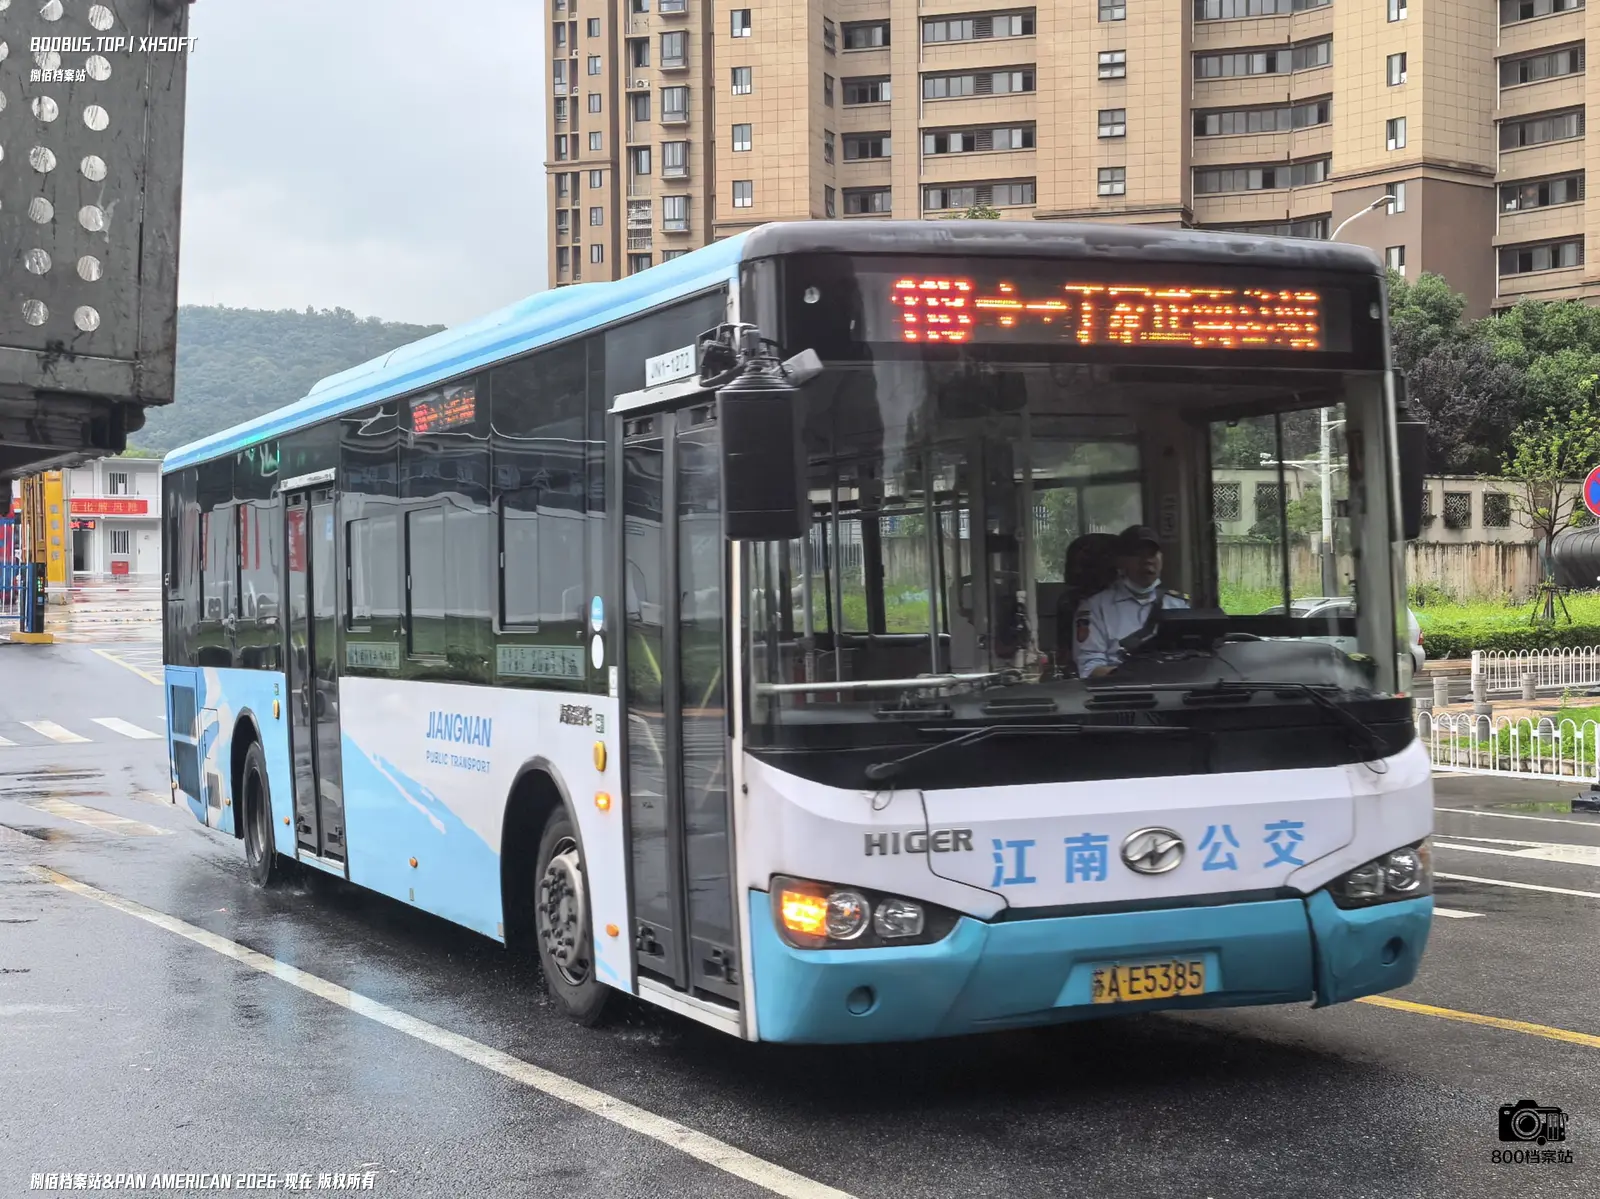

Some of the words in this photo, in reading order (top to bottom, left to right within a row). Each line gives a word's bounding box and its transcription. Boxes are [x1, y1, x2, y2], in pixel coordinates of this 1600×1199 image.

[426, 711, 492, 747] JIANGNAN
[426, 750, 448, 765] PUBLIC
[450, 754, 490, 774] TRANSPORT
[864, 828, 974, 856] HIGER
[991, 832, 1110, 888] 江南
[1199, 819, 1305, 872] 公交
